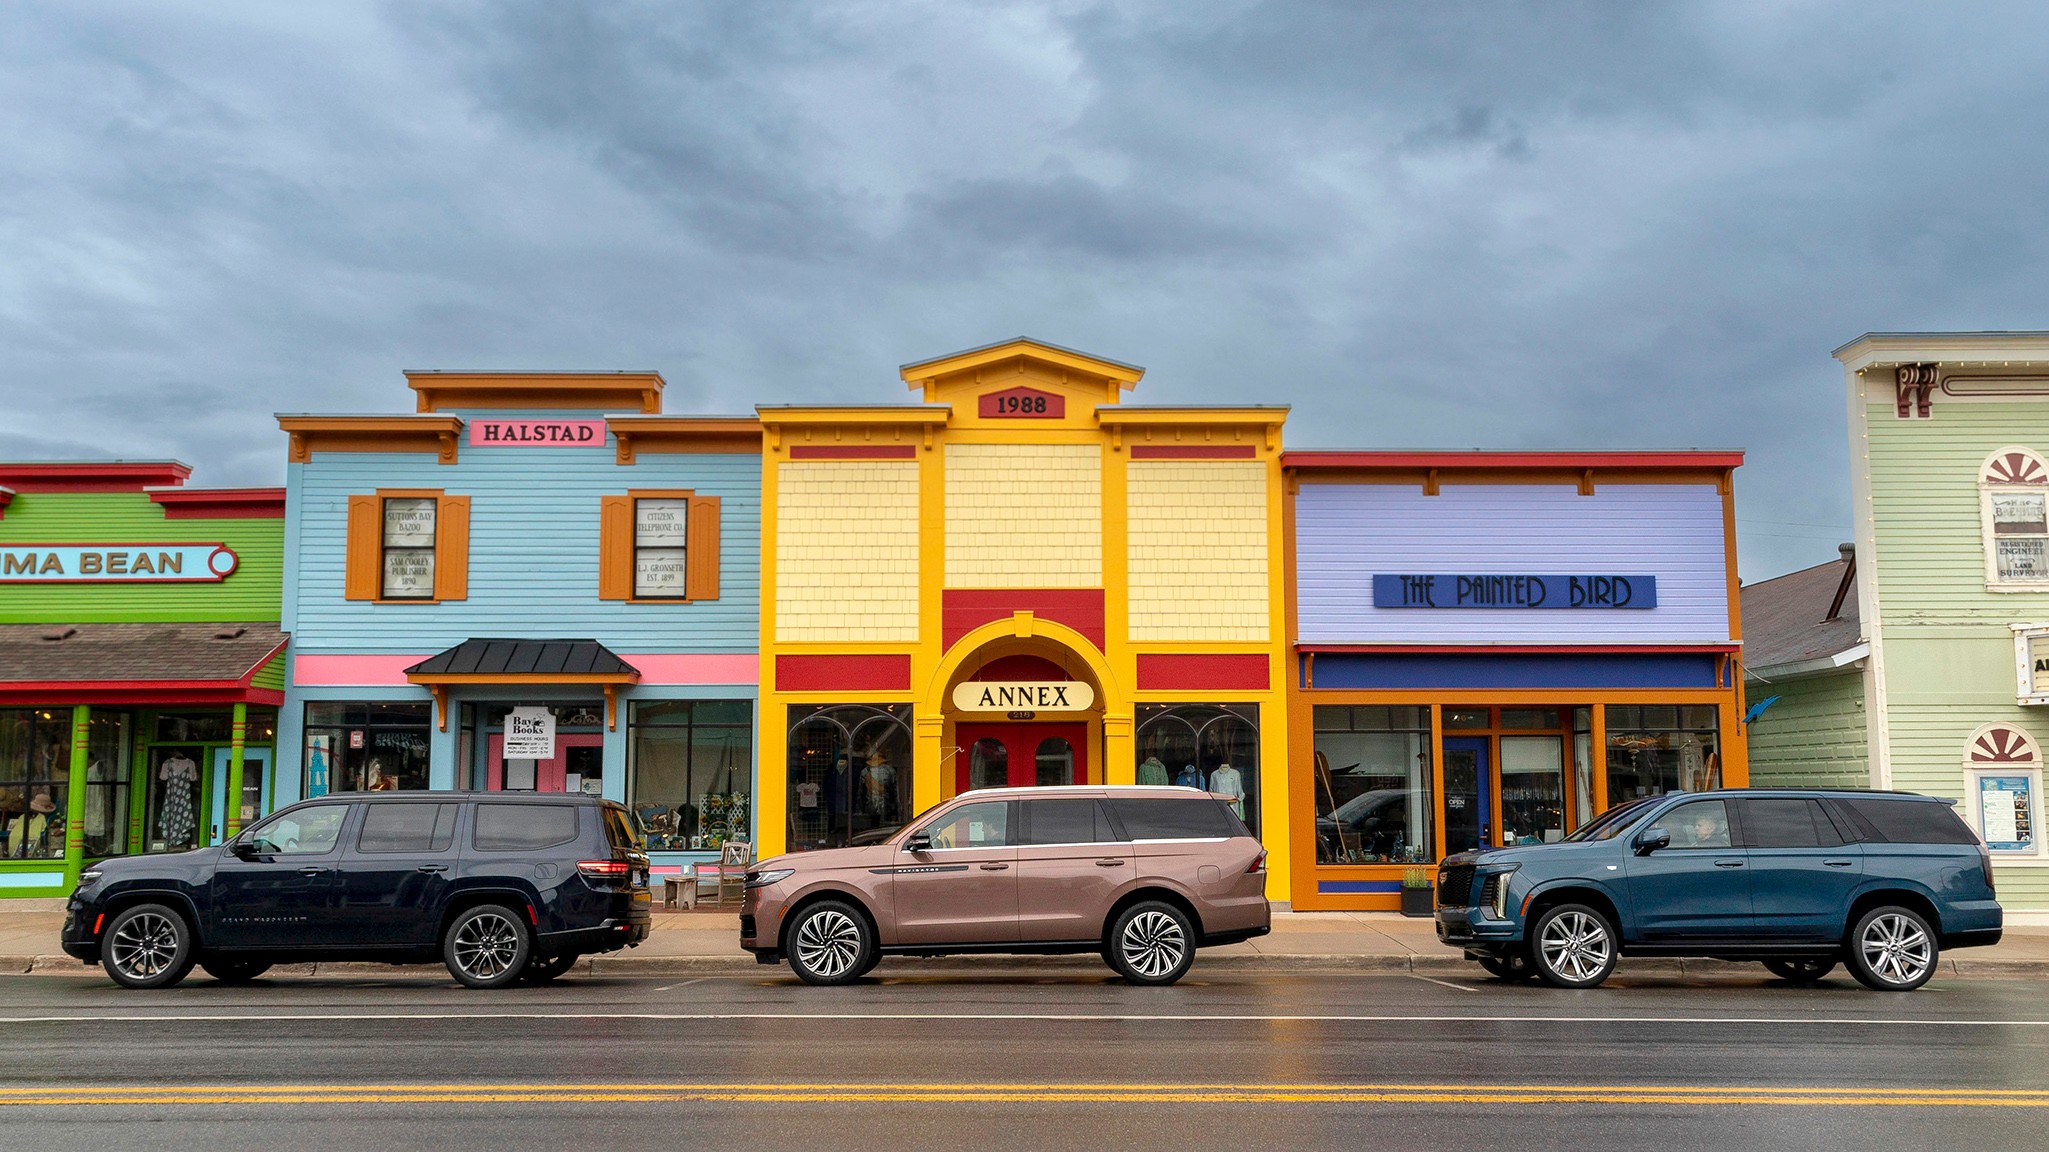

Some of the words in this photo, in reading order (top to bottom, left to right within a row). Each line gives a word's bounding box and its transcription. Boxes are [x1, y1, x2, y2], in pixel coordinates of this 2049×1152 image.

[998, 396, 1047, 414] 1988
[483, 424, 594, 442] HALSTAD
[387, 512, 418, 521] SUTTONS
[419, 512, 433, 521] BAY
[647, 512, 675, 521] CITIZENS
[399, 523, 421, 532] BAZOO
[637, 523, 672, 532] TELEPHONE
[673, 523, 684, 532] CO.
[0, 552, 65, 574] MA
[79, 552, 183, 574] BEAN
[390, 557, 404, 566] SAM
[404, 557, 429, 566] COOLEY
[391, 567, 427, 576] PUBLISHER
[650, 563, 684, 572] GRONSETH
[646, 573, 660, 582] EST.
[661, 573, 675, 582] 1899
[1999, 569, 2049, 577] SURVEYOR
[401, 577, 416, 585] 1890
[1400, 575, 1436, 608] THE
[1456, 575, 1547, 608] PAINTED
[1569, 575, 1632, 608] BIRD
[978, 686, 1070, 707] ANNEX
[513, 716, 531, 727] Bay
[513, 725, 544, 734] Books
